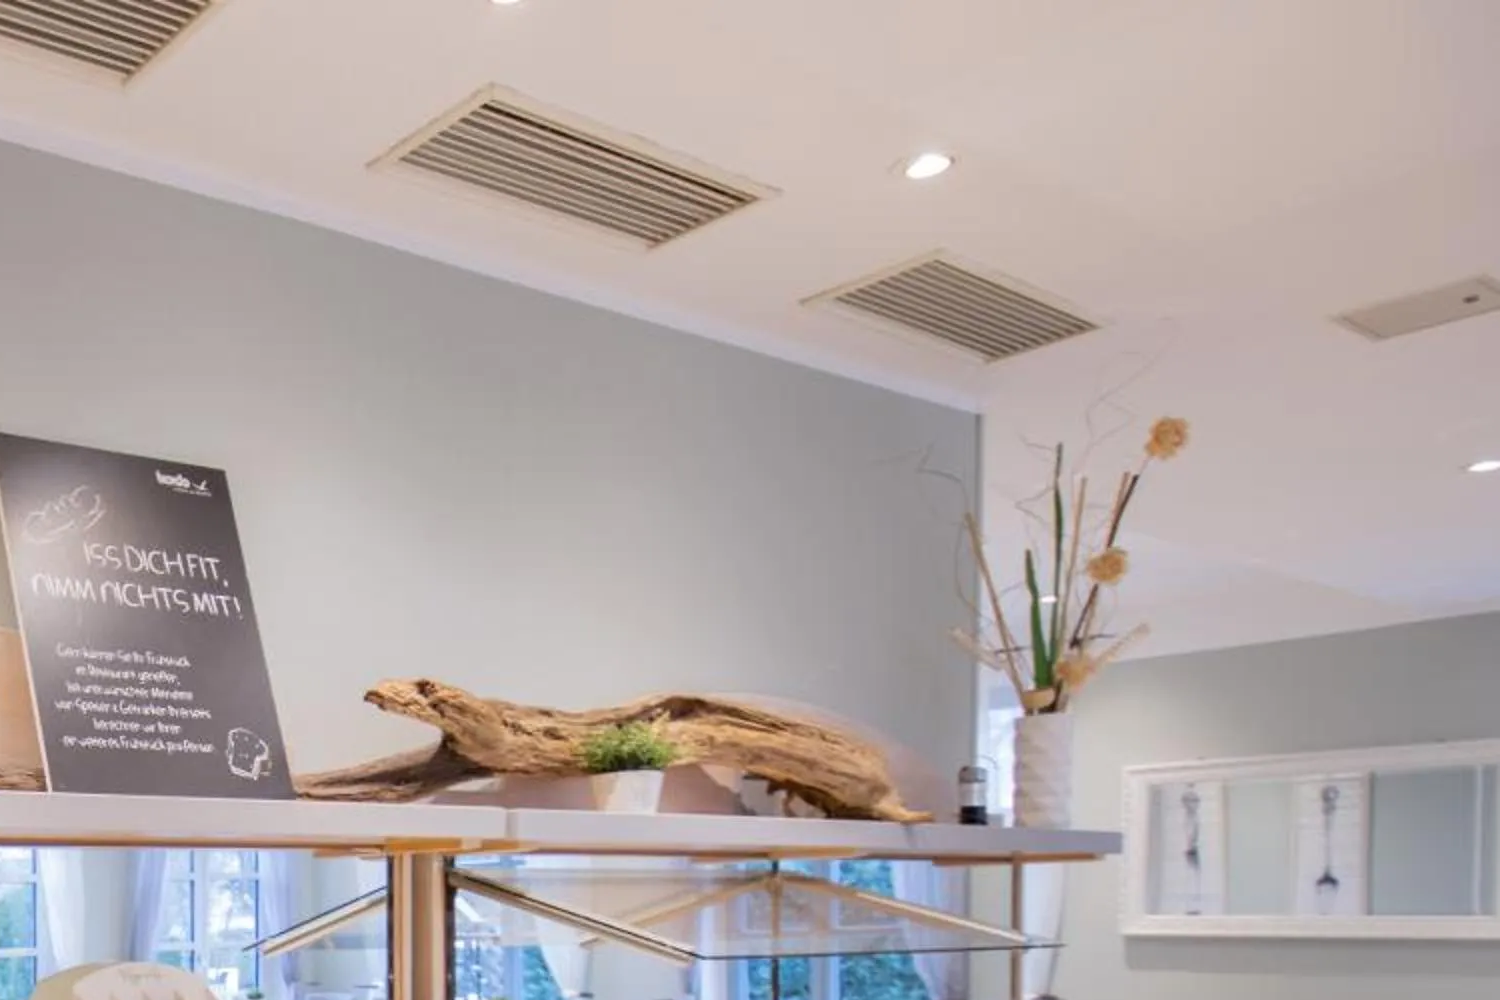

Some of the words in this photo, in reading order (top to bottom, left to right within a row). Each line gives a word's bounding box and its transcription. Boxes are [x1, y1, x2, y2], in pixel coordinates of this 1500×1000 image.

[83, 541, 122, 570] ISS
[123, 543, 185, 577] DICH
[100, 579, 191, 613] NICHTS
[191, 592, 244, 620] MIT!
